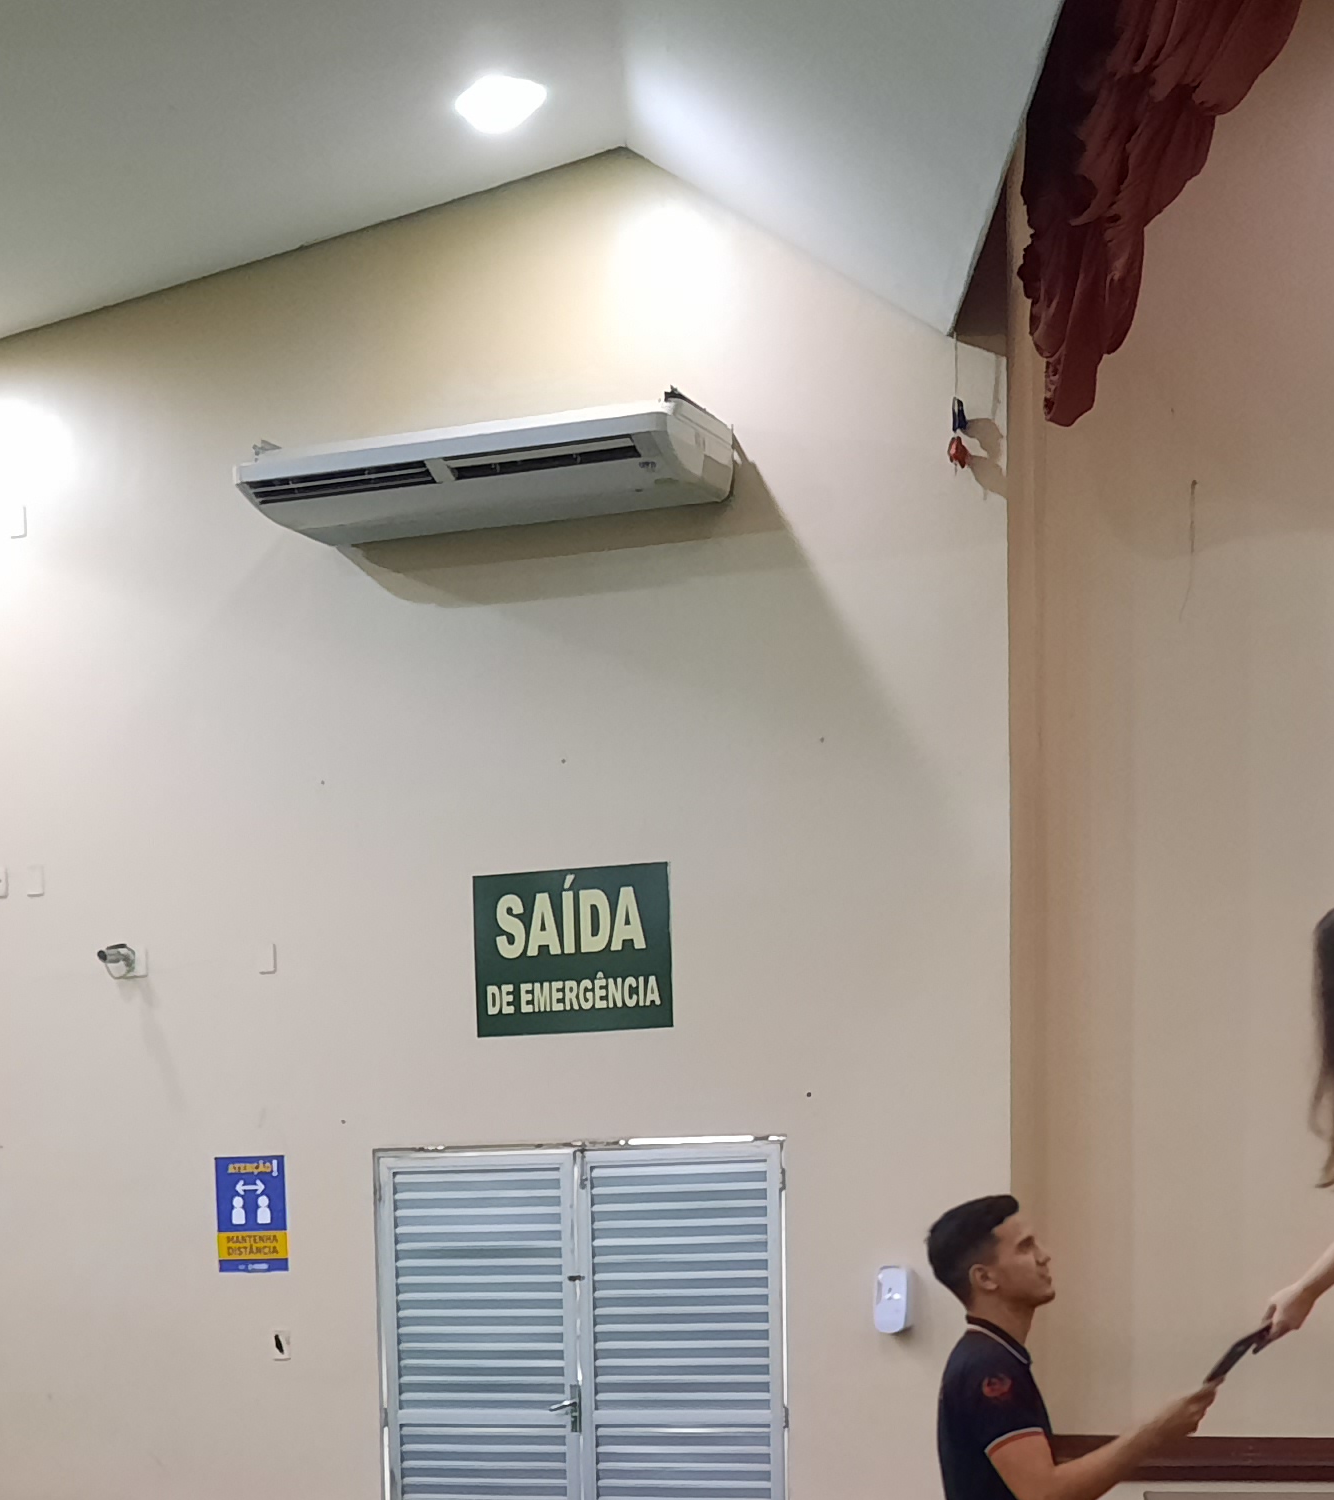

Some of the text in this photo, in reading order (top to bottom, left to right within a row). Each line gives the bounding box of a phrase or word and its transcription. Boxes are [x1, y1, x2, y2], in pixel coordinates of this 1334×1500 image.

[495, 874, 646, 959] SAÍDA
[486, 971, 661, 1015] DE EMERGÊNCIA
[226, 1234, 278, 1244] MANTENHA
[227, 1243, 279, 1256] DISTÂNCIA
